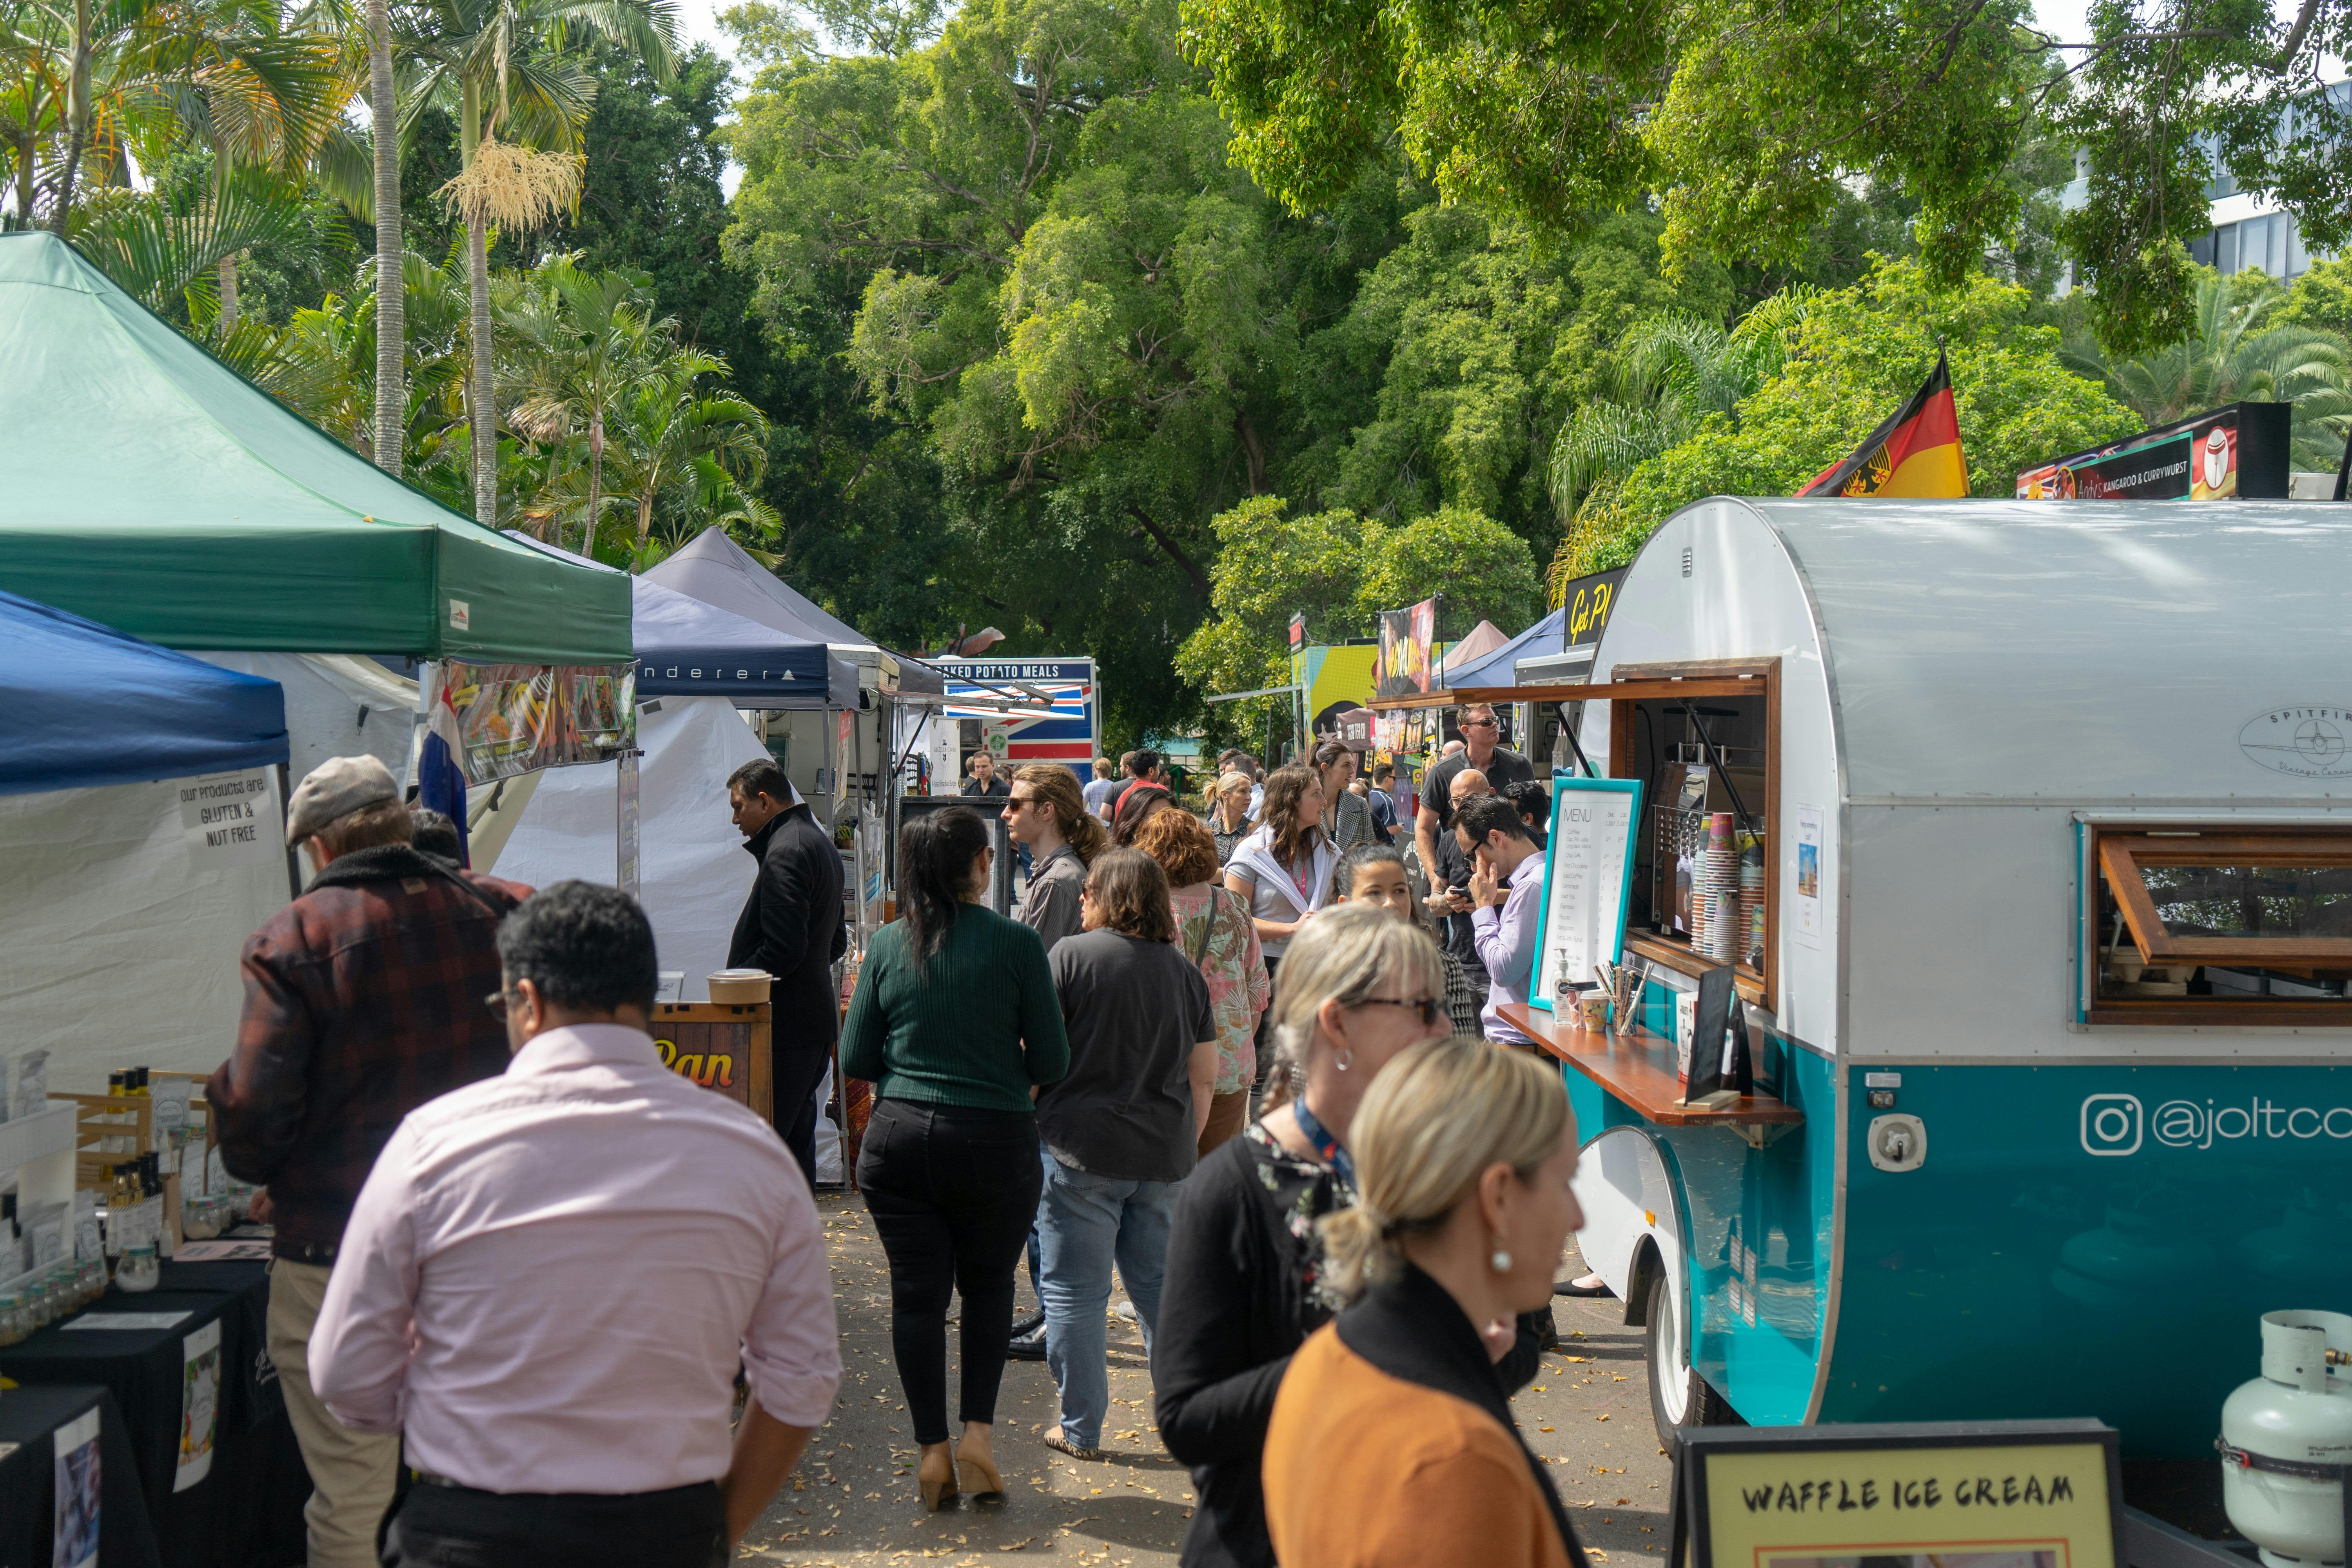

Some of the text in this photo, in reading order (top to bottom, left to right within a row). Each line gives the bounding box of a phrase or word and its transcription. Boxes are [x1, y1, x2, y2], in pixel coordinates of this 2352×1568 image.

[2103, 474, 2136, 493] KANGAROO
[2138, 474, 2142, 484] &
[2143, 461, 2187, 483] CURRYWURST
[1571, 589, 1589, 645] Get
[645, 666, 768, 680] nderer
[1023, 666, 1058, 677] MEALS
[2270, 710, 2352, 723] SPITFIR
[2279, 762, 2319, 776] Vintage
[200, 802, 254, 824] GLUTEN &
[1564, 808, 1592, 822] MENU
[206, 825, 256, 847] NUT FREE
[2152, 1096, 2352, 1150] @joltco
[1742, 1475, 2074, 1514] WAFFLE ICE CREAM
